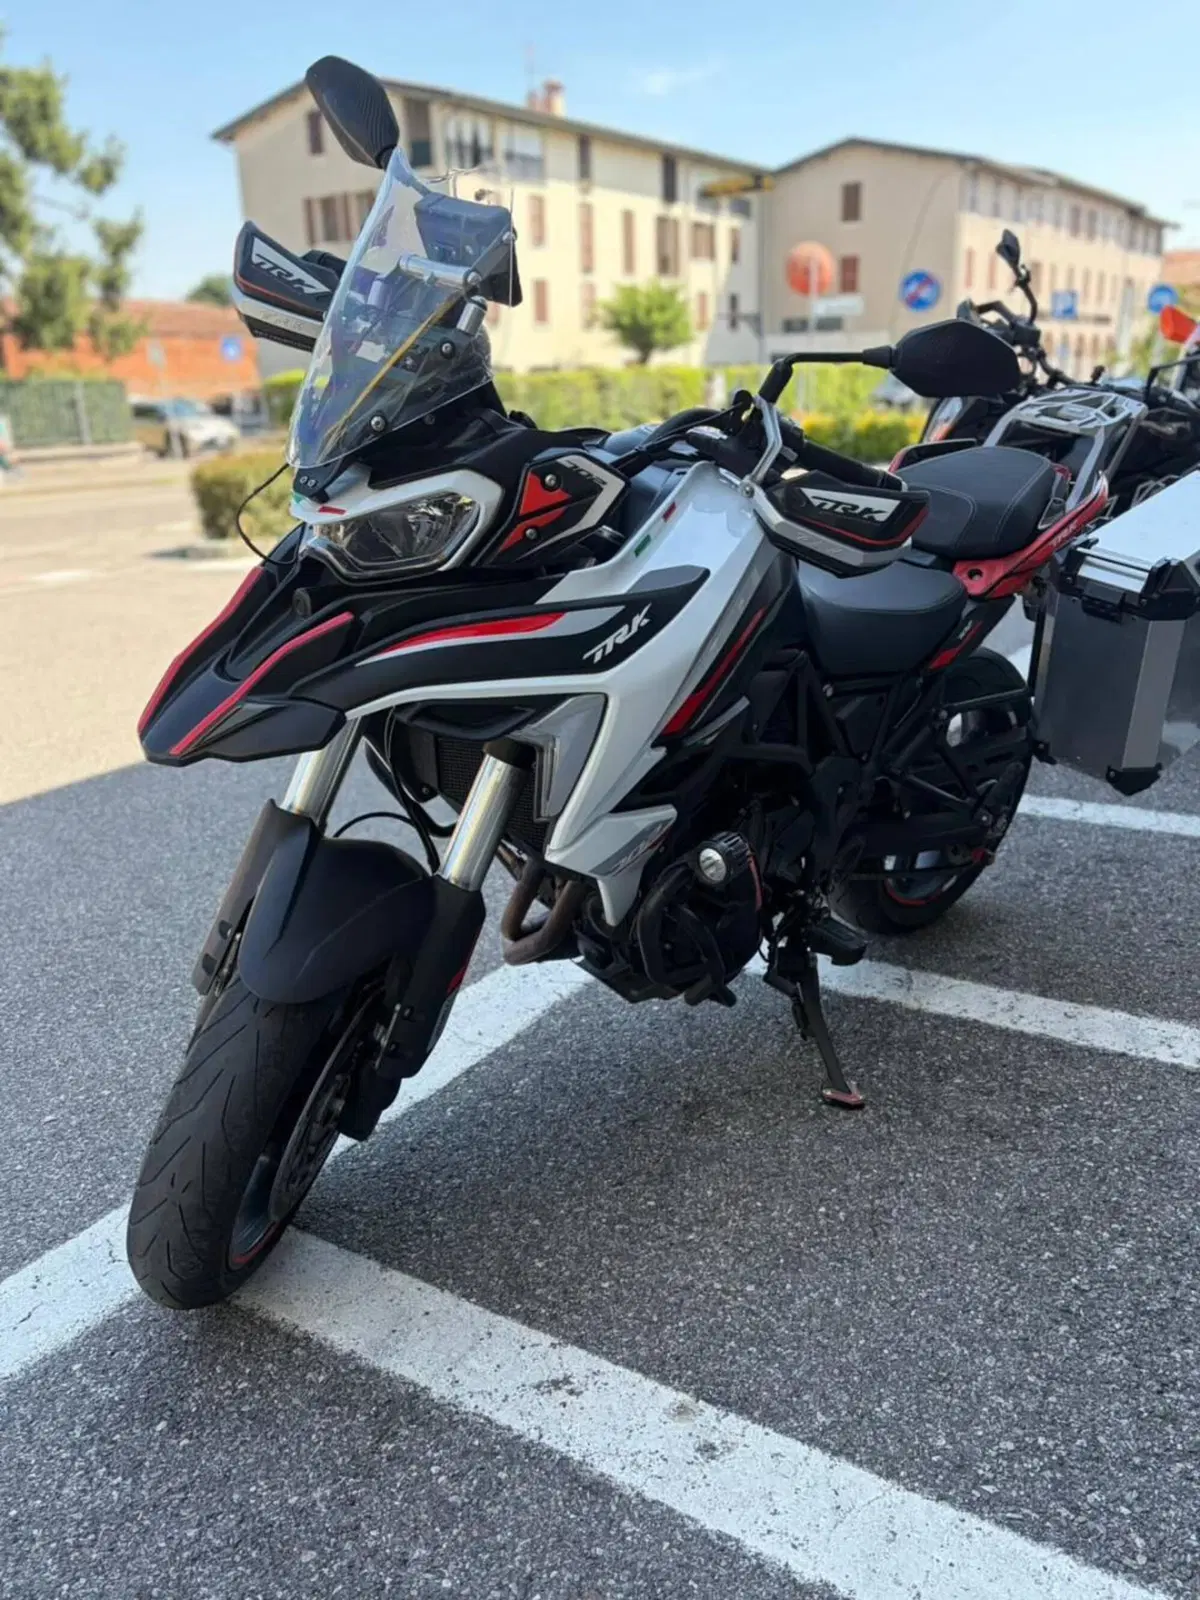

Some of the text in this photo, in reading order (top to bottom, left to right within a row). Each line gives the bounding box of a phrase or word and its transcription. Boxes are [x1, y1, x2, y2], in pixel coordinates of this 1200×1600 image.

[252, 253, 317, 296] TRK
[811, 495, 888, 520] TRK
[582, 602, 653, 664] TRK
